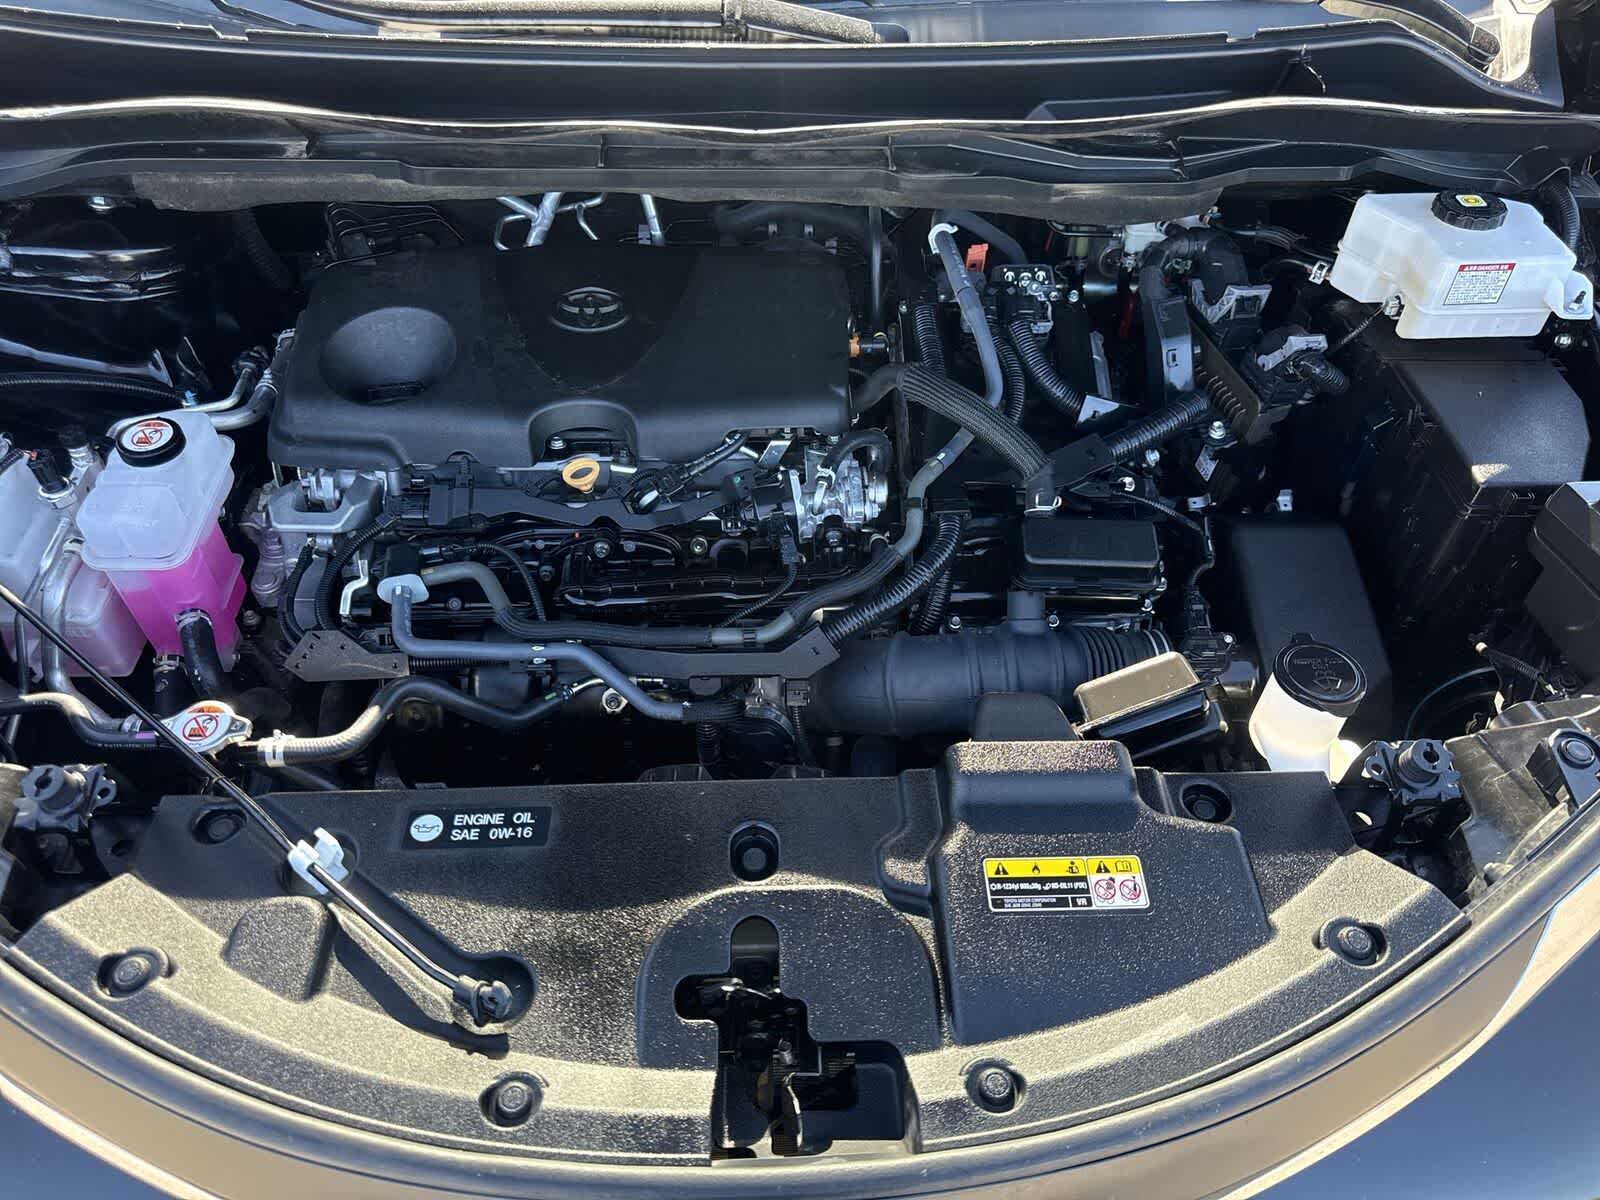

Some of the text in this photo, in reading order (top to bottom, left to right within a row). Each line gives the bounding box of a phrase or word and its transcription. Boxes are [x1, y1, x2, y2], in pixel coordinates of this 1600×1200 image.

[453, 812, 536, 826] ENGINE OIL
[450, 827, 533, 841] SAE 0W-16
